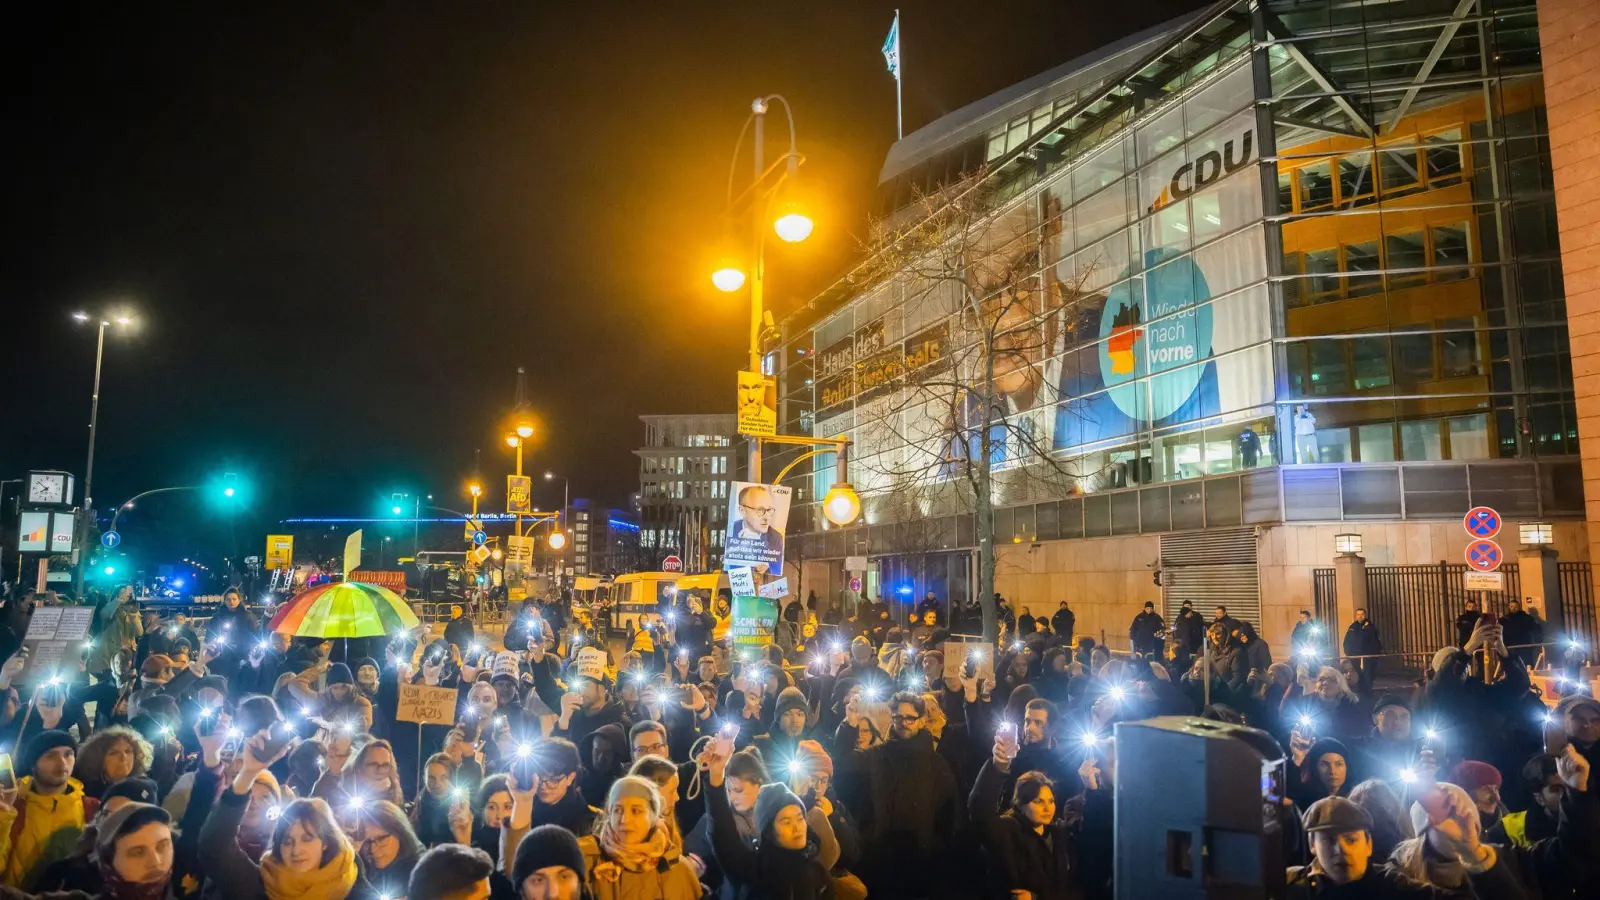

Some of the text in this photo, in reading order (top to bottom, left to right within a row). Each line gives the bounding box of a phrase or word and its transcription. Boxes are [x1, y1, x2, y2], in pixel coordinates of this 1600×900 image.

[1170, 130, 1253, 199] CDU
[1150, 325, 1185, 343] nach
[823, 334, 880, 376] Haus des
[1150, 344, 1194, 363] vorne
[509, 492, 527, 502] AfD
[751, 539, 767, 547] Land,
[665, 562, 681, 570] STOP
[734, 627, 750, 635] UND
[411, 706, 442, 719] NAZIS
